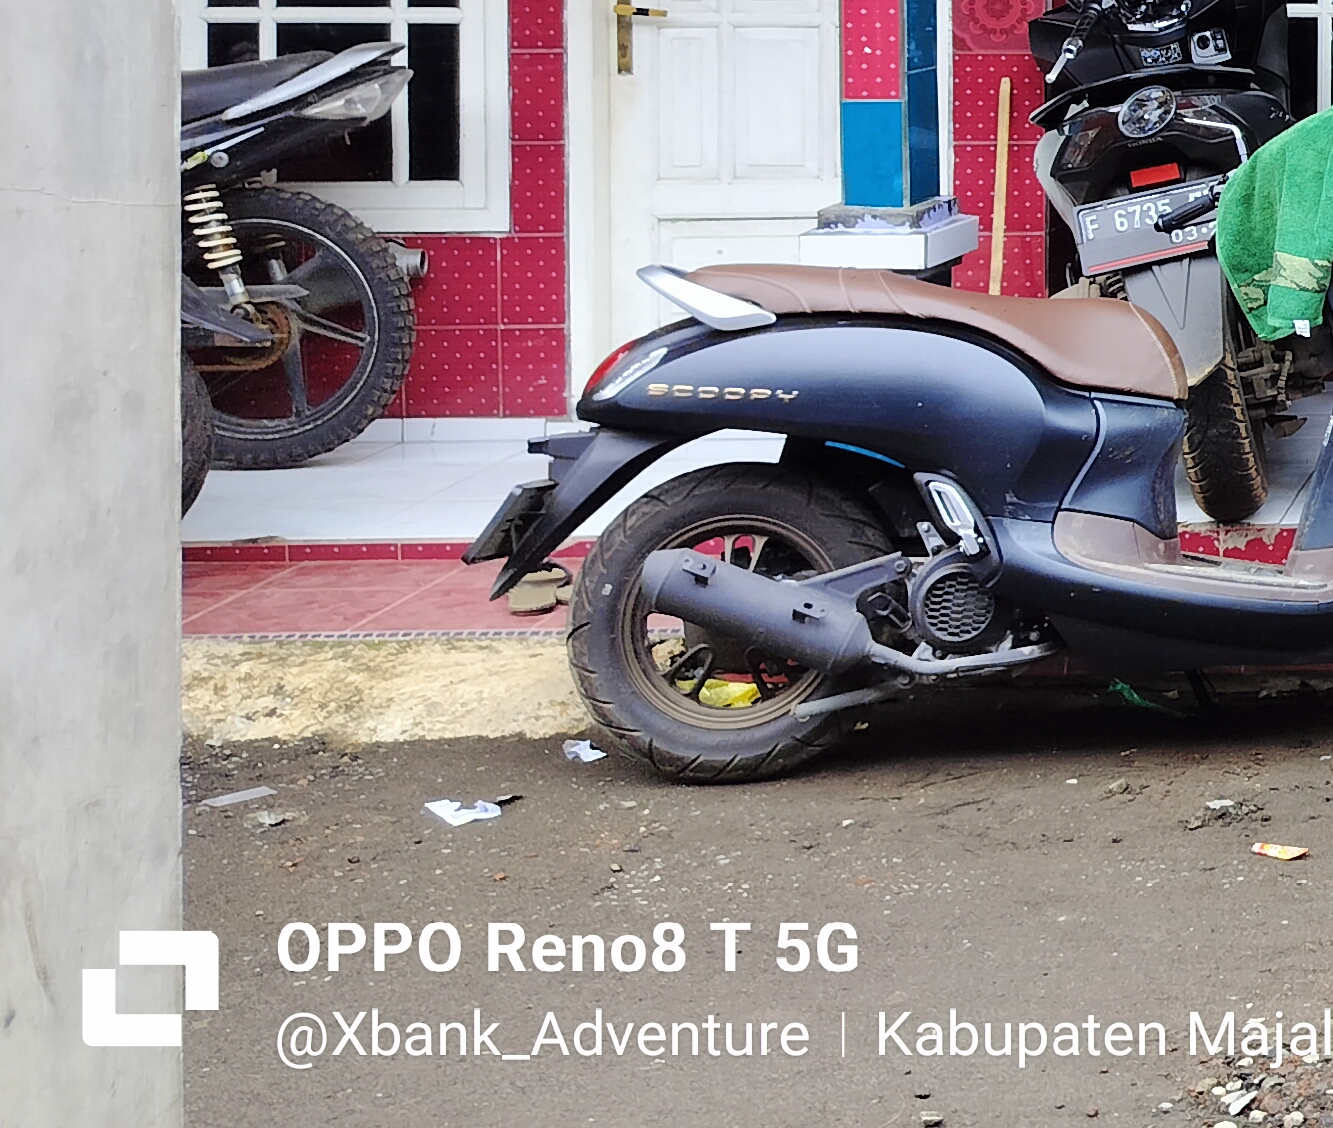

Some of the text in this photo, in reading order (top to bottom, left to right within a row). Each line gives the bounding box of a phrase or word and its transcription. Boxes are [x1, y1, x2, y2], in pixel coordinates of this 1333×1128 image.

[1085, 198, 1172, 240] F 6735
[645, 382, 799, 403] SCOOPY
